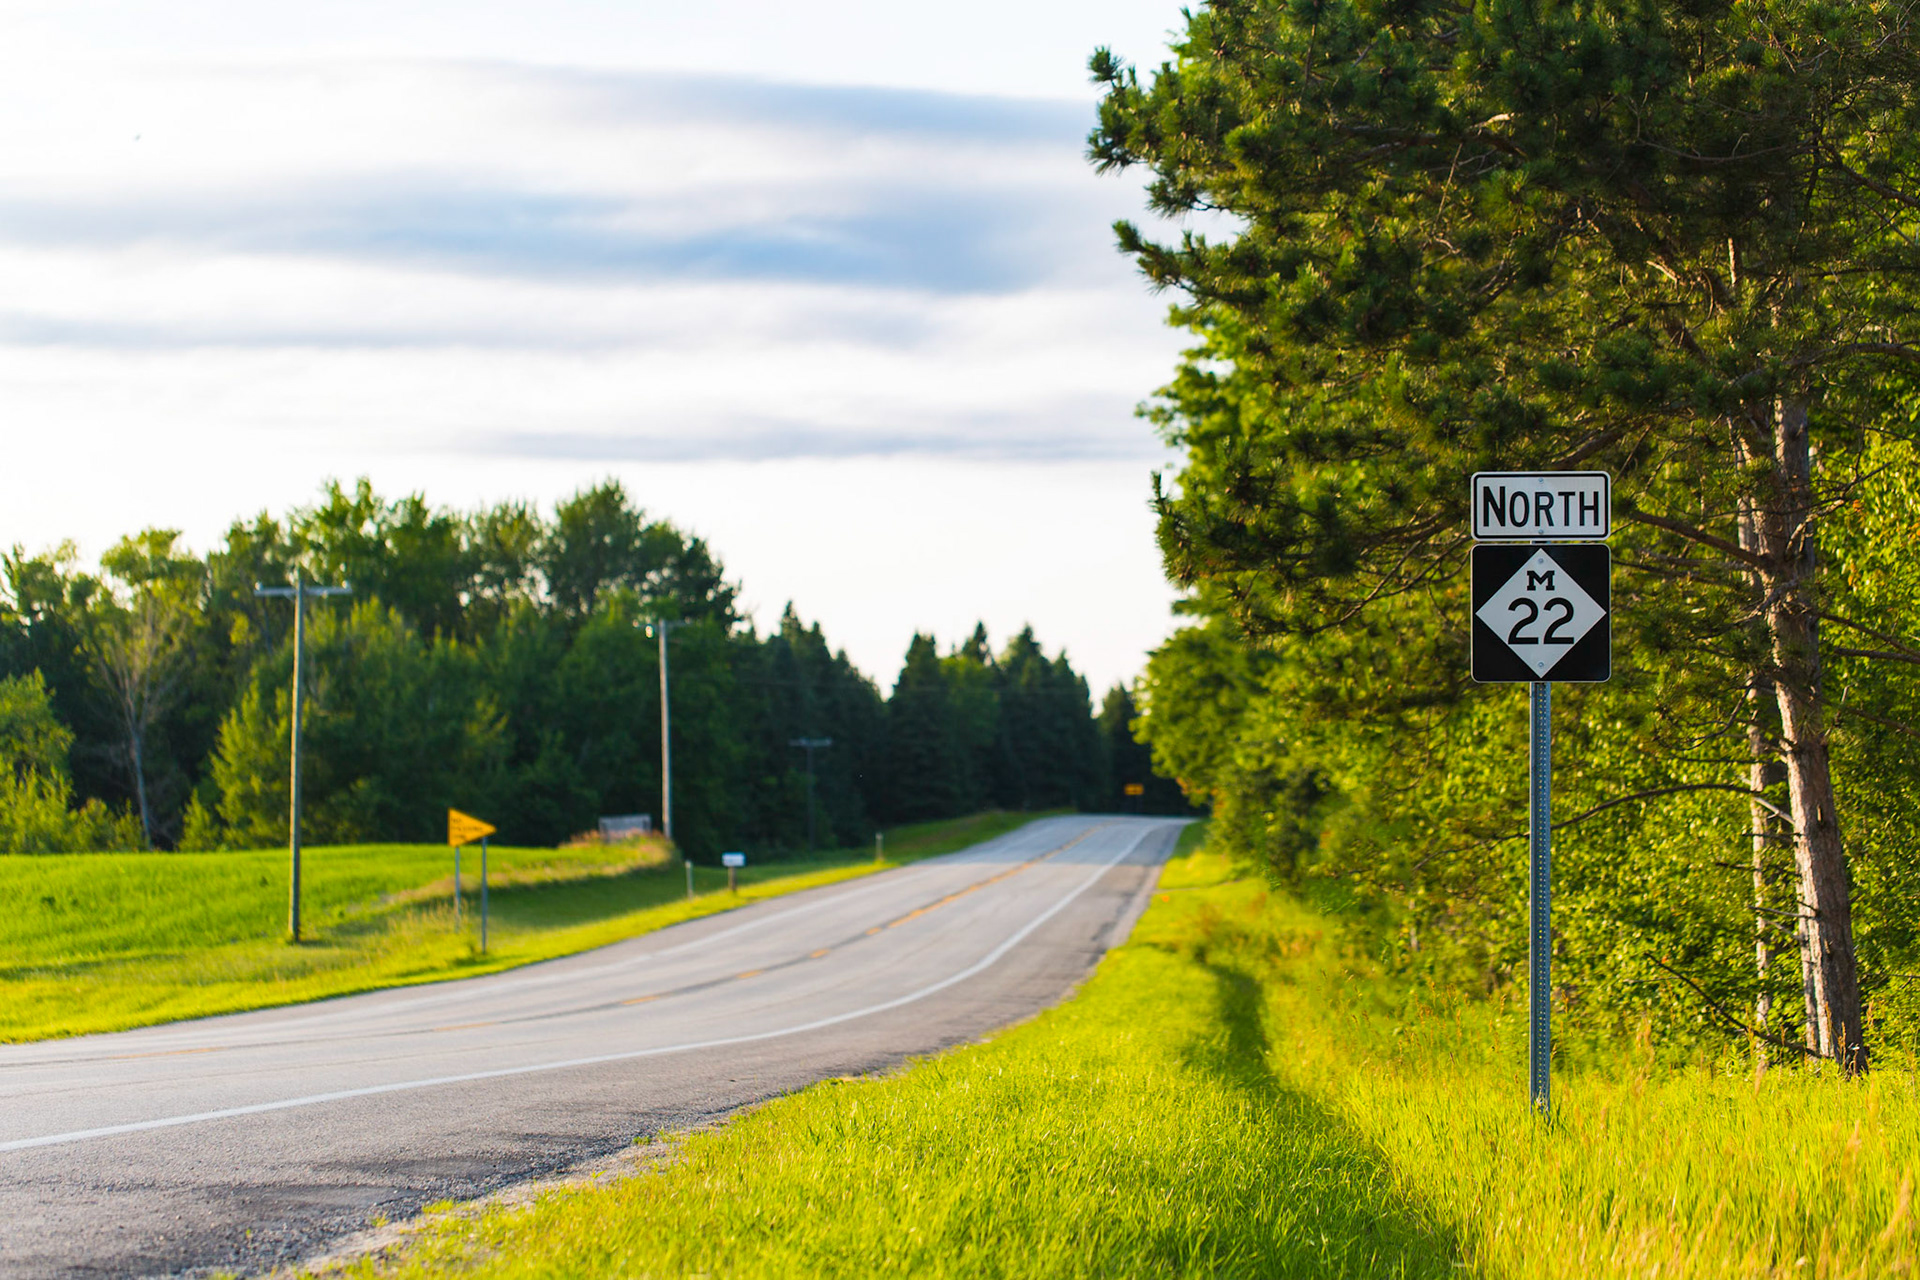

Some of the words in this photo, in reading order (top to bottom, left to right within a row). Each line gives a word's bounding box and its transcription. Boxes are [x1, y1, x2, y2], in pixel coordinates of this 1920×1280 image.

[1482, 485, 1600, 528] NORTH
[1526, 570, 1556, 591] M
[1507, 597, 1575, 645] 22
